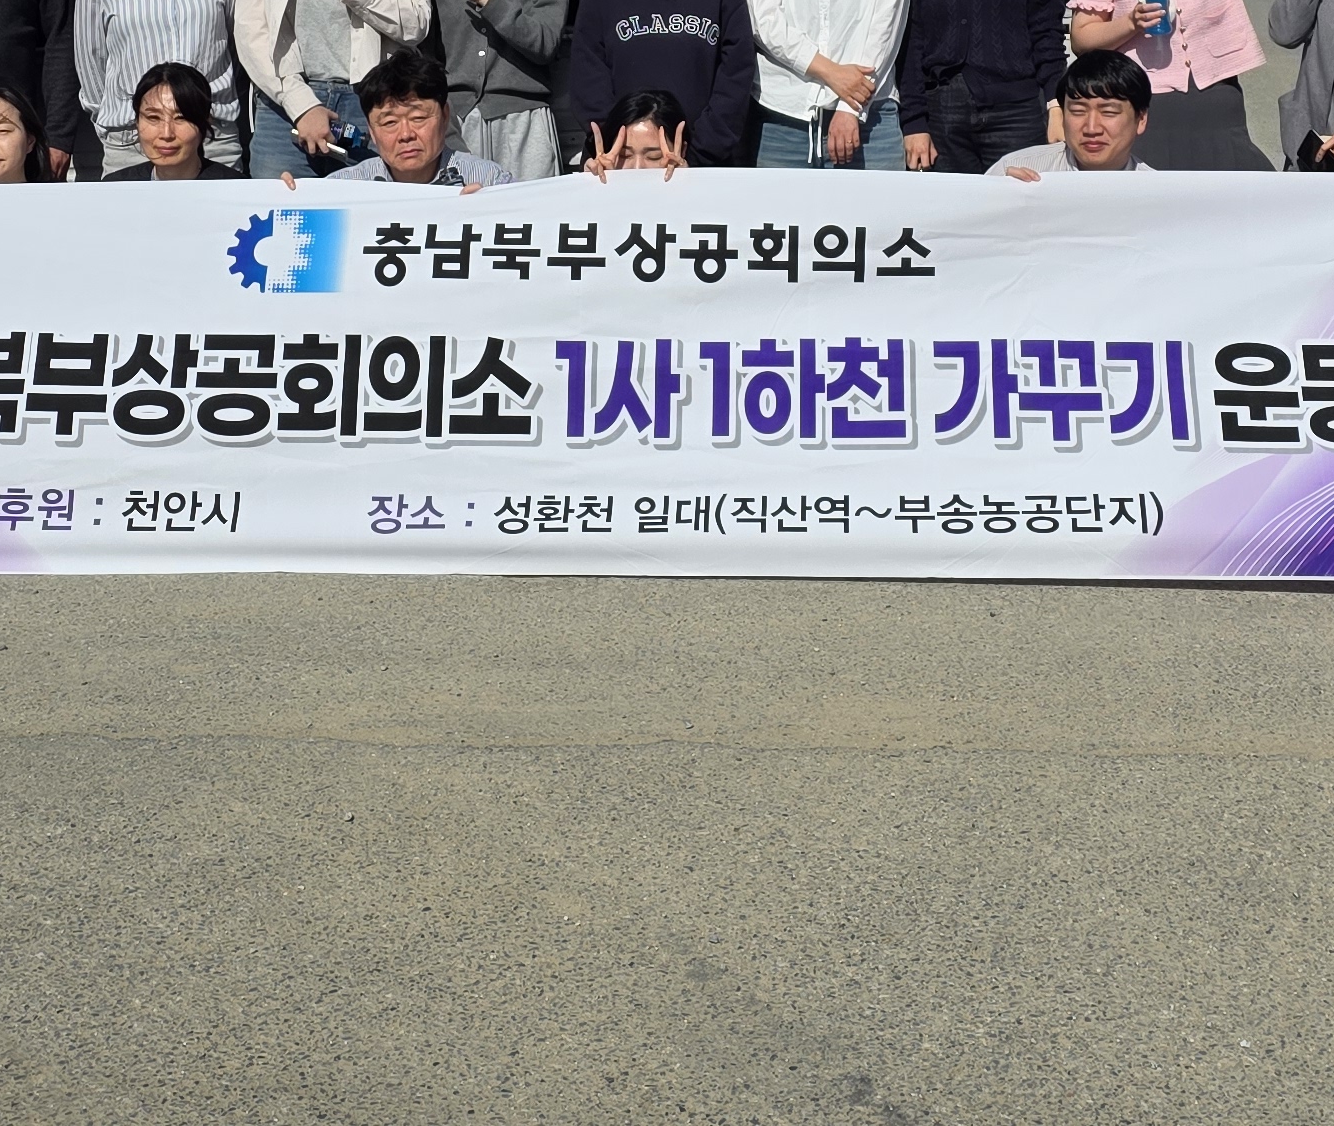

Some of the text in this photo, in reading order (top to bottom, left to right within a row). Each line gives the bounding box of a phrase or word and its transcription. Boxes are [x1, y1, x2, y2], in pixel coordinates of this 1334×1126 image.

[616, 13, 720, 46] CLASSIC
[362, 222, 936, 287] 충남북부상공회의소
[554, 338, 681, 439] 1사
[698, 337, 908, 439] 1하천
[933, 338, 1190, 441] 가꾸기
[121, 490, 241, 533] 천안시
[367, 493, 446, 535] 장소
[493, 494, 614, 535] 성환천
